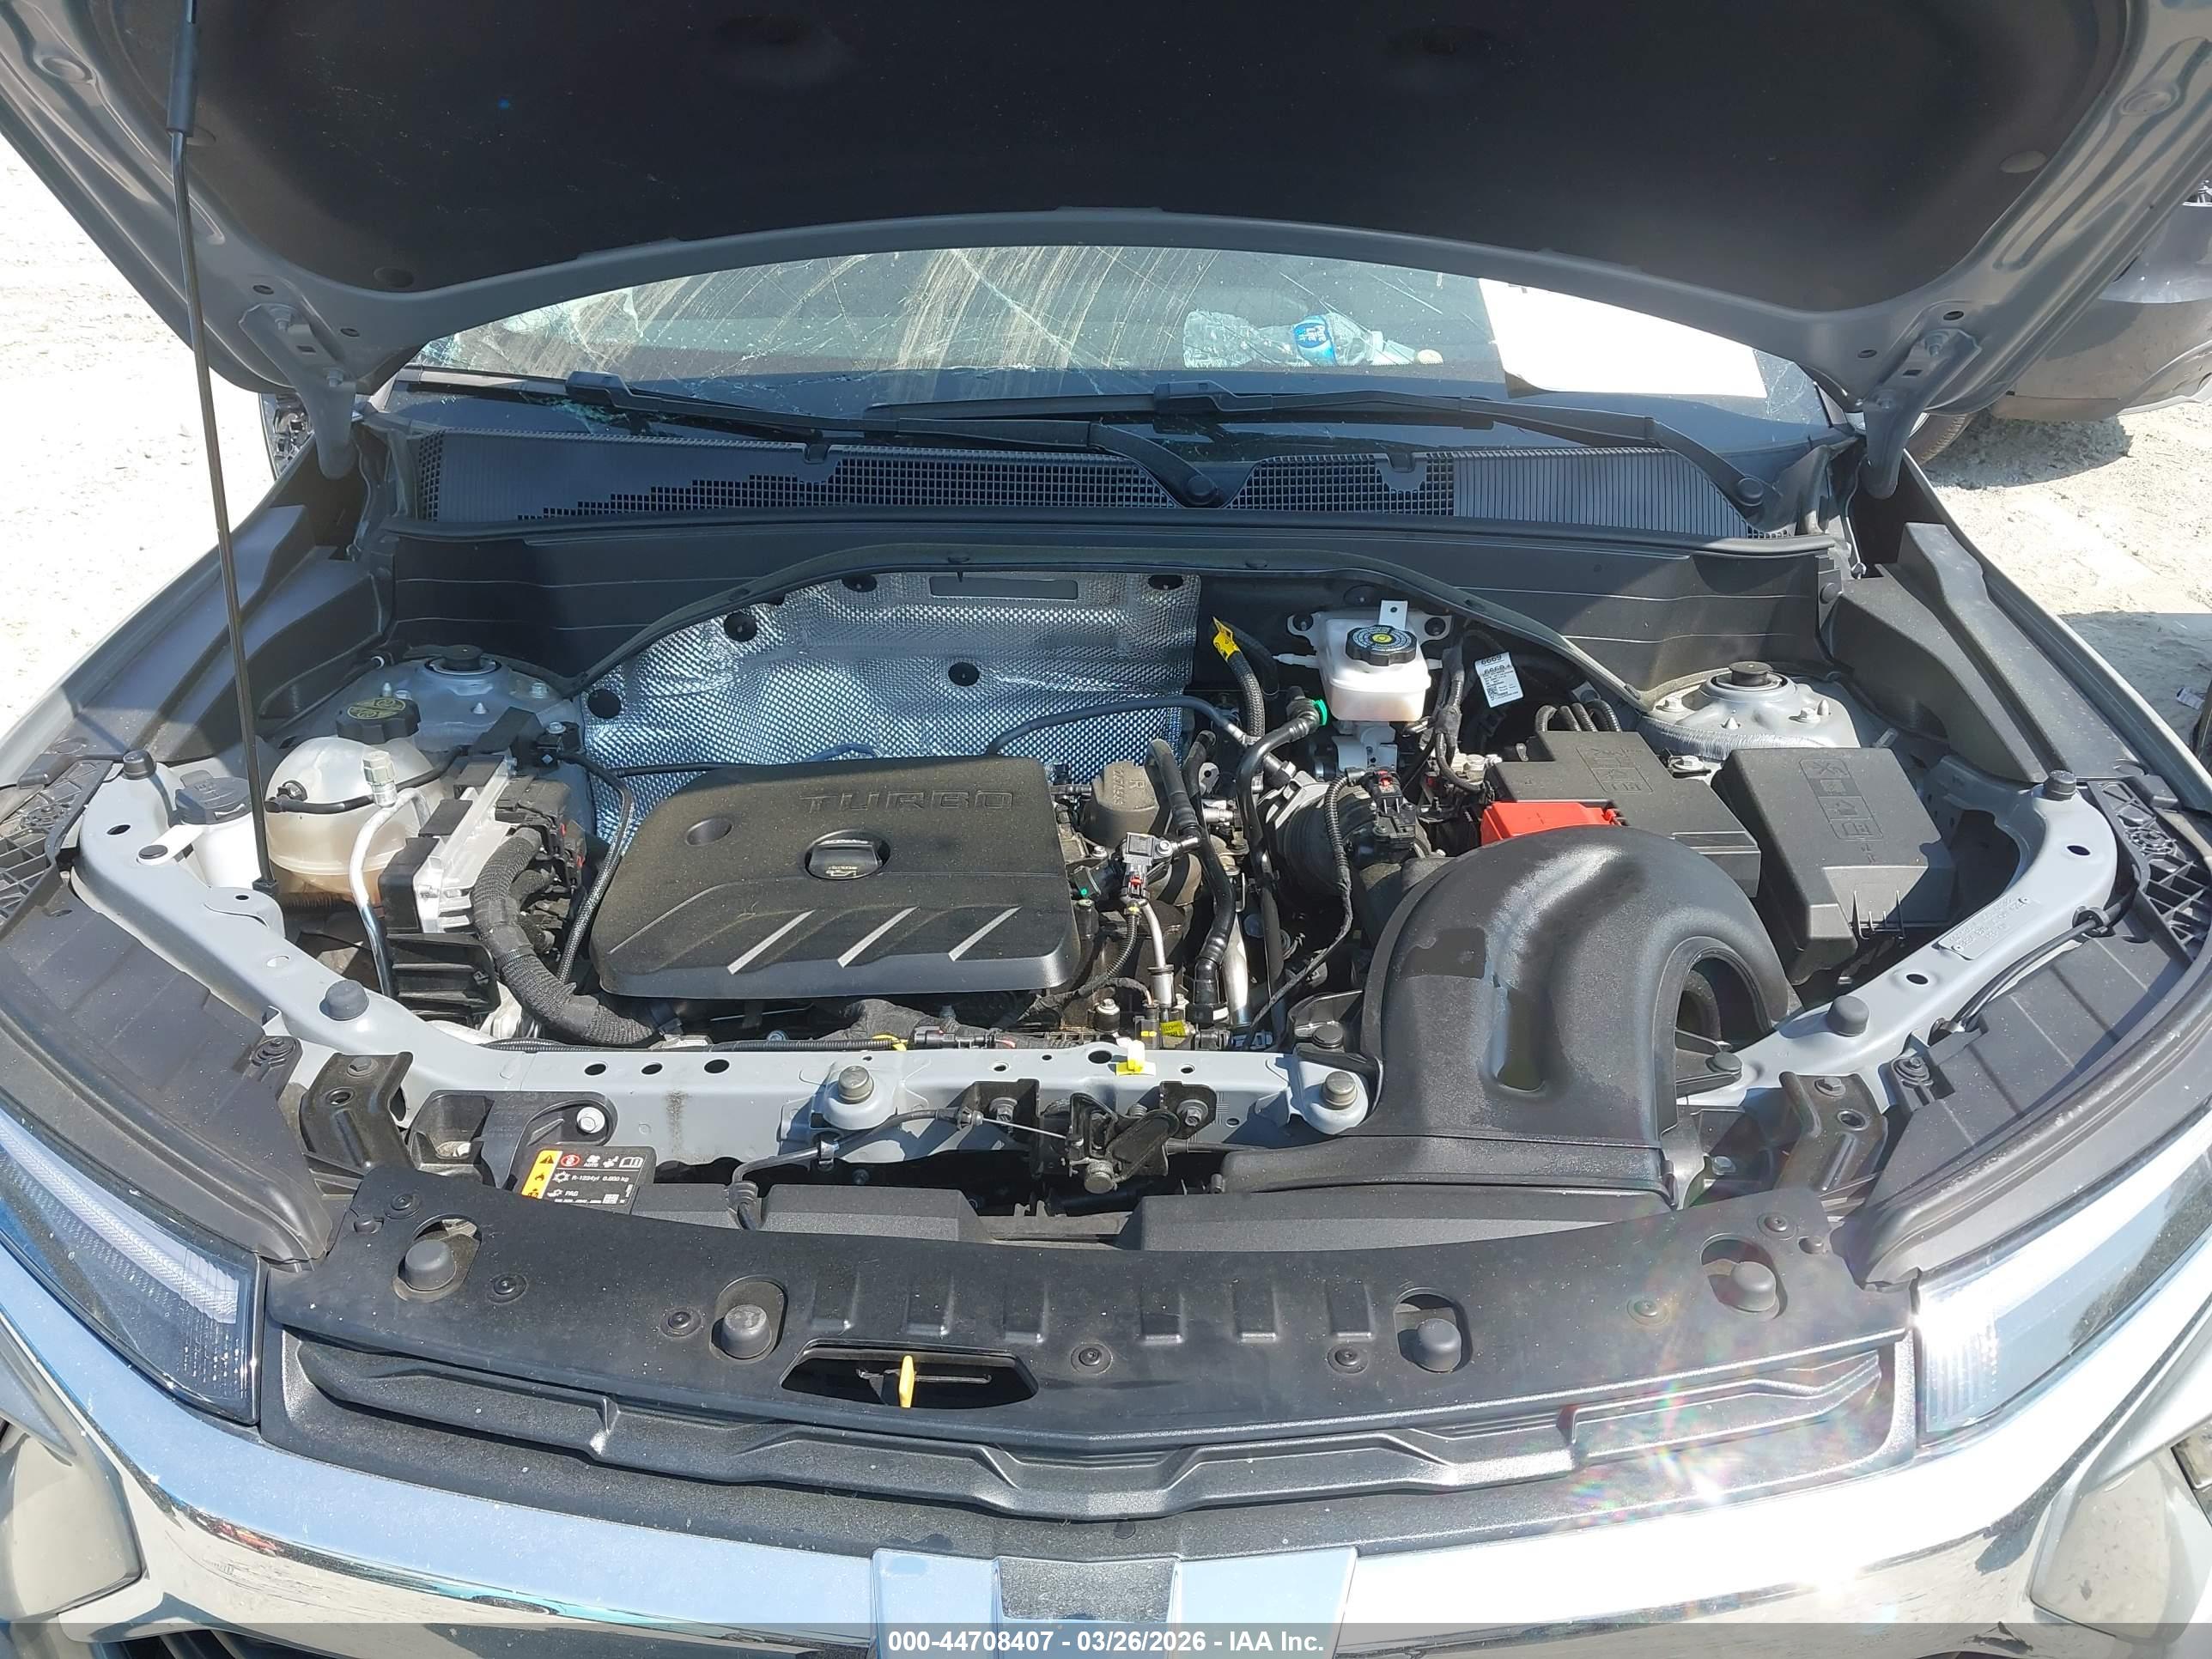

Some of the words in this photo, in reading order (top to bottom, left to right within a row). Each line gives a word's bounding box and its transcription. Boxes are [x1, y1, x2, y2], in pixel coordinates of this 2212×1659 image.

[1304, 327, 1317, 342] Life
[1315, 325, 1327, 342] Pure
[799, 790, 1014, 814] TURBO
